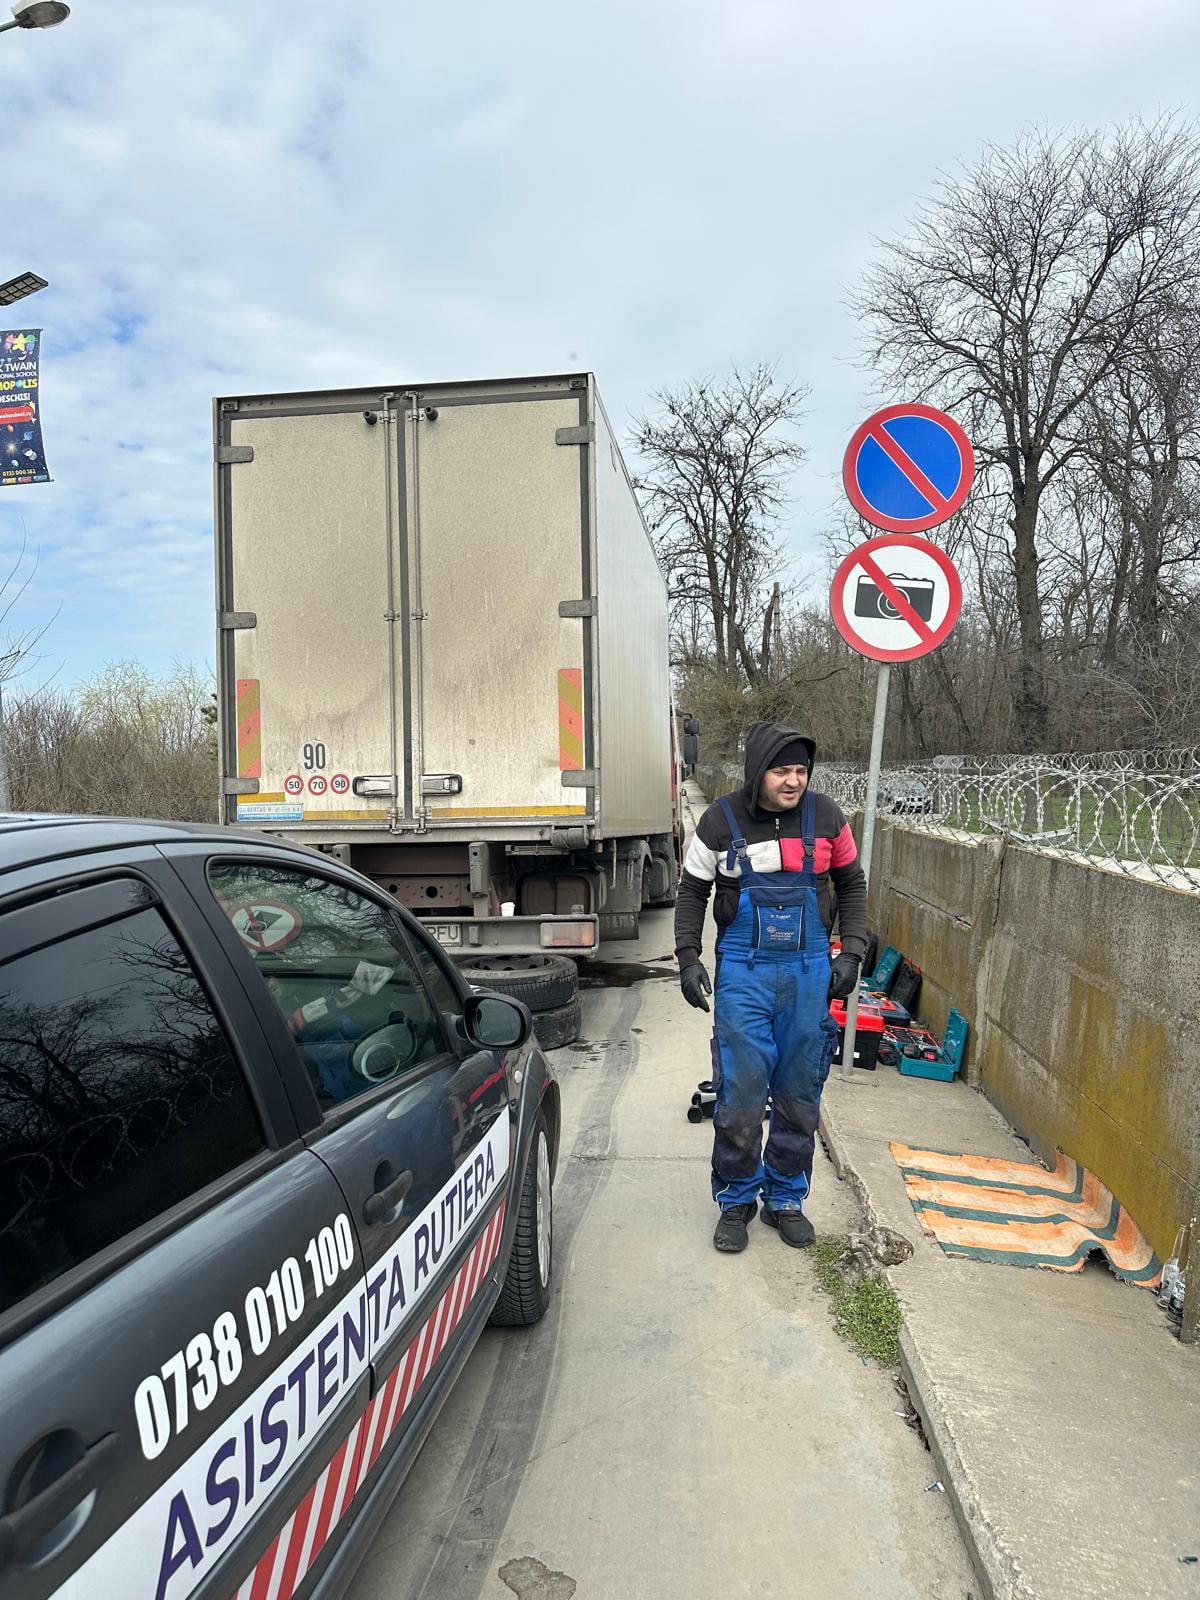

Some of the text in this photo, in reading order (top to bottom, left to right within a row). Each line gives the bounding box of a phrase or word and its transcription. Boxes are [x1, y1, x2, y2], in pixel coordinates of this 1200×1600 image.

[5, 361, 36, 372] TWAIN
[303, 743, 326, 770] 90
[288, 780, 300, 790] 50
[312, 780, 324, 790] 70
[334, 779, 346, 789] 90
[134, 1213, 354, 1460] 0738 010 100
[154, 1140, 496, 1600] ASISTENTA RUTIERA
